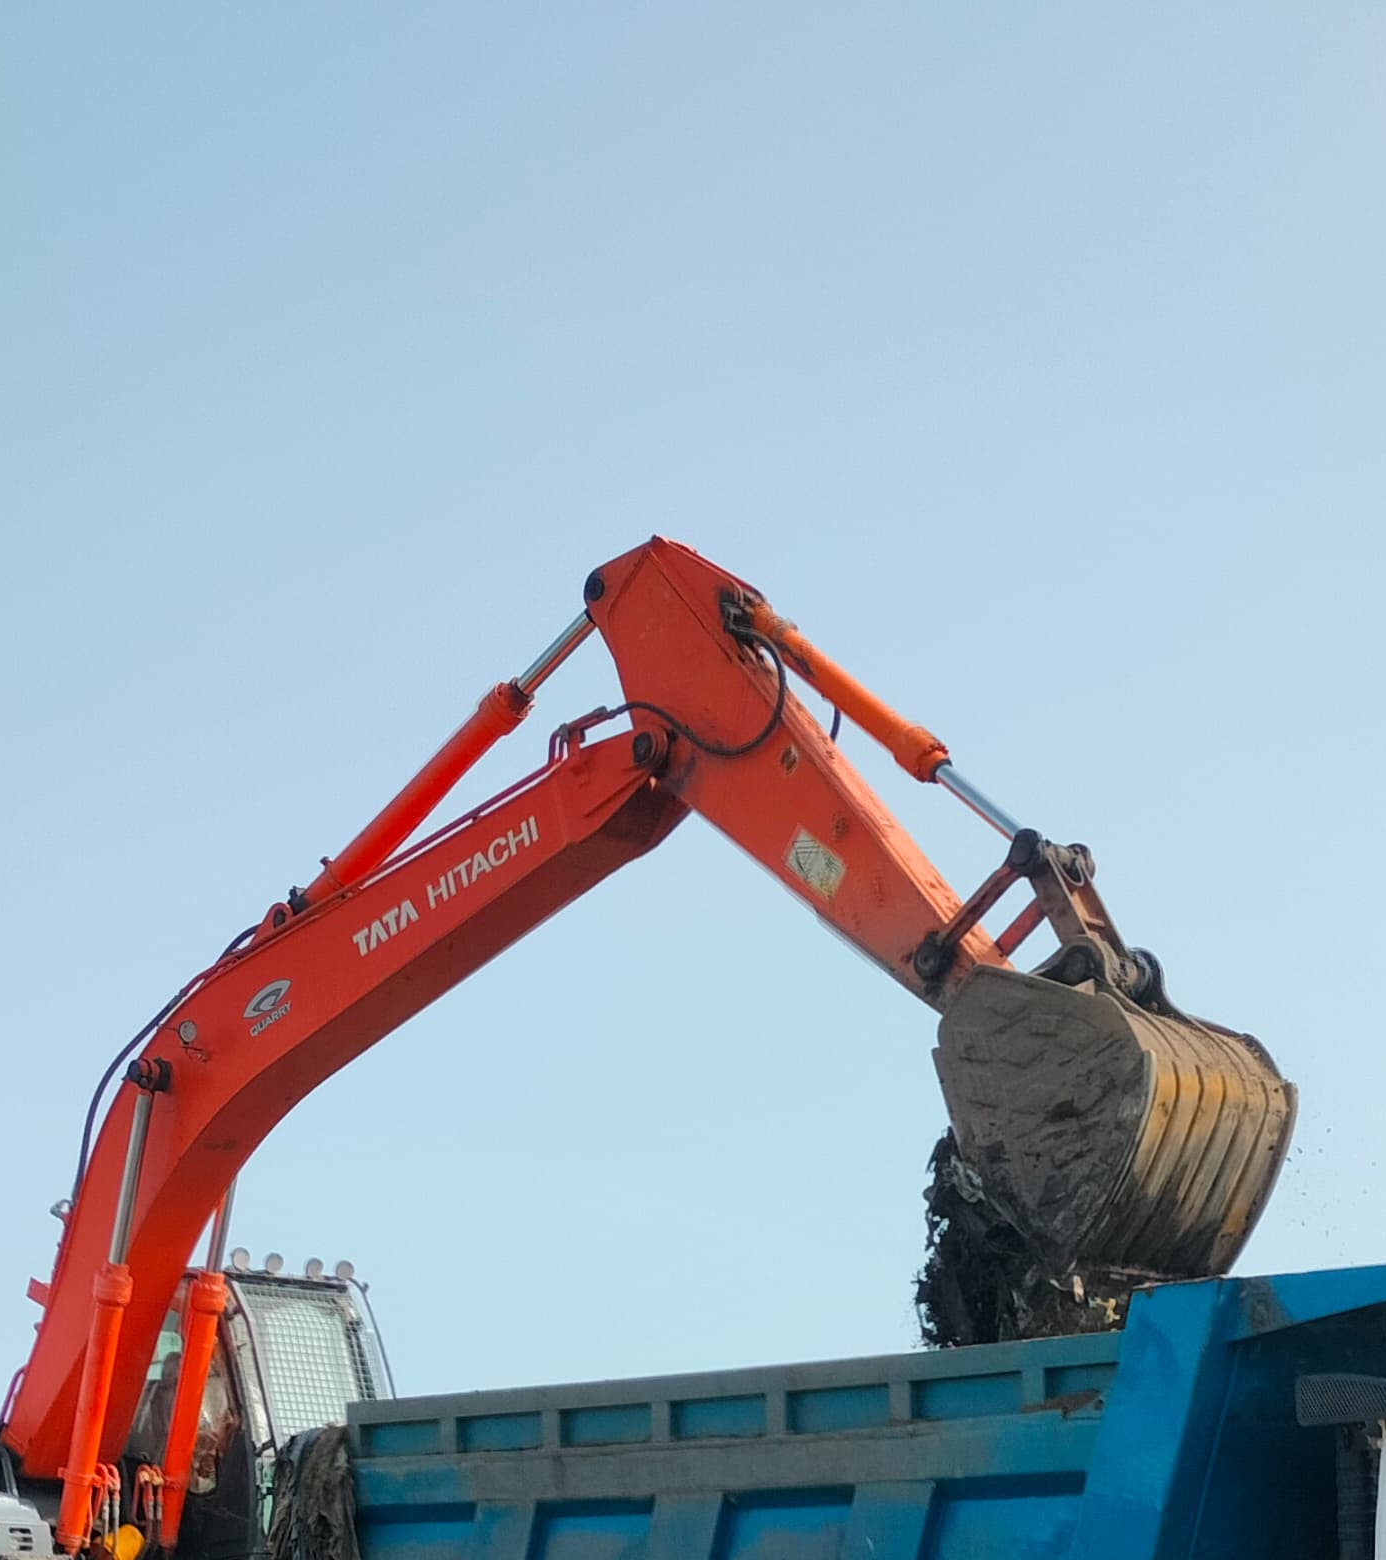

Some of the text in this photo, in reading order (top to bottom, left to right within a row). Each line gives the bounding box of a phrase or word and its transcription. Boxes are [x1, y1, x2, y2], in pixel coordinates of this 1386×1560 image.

[352, 815, 540, 957] TATA HITACHI
[249, 1001, 293, 1038] QUARRY
